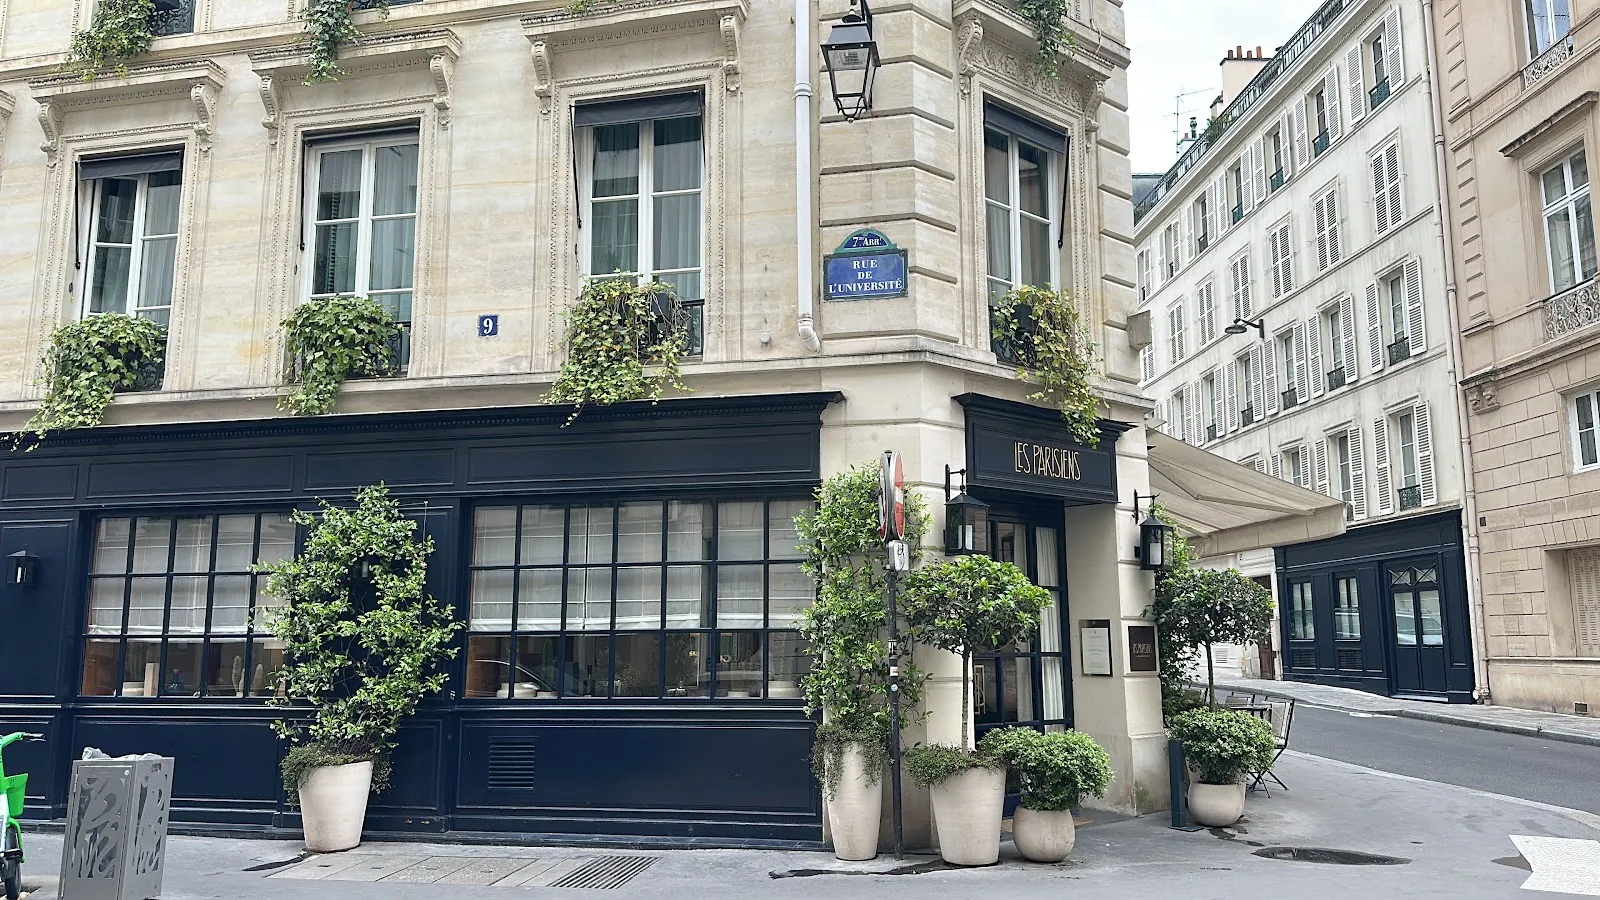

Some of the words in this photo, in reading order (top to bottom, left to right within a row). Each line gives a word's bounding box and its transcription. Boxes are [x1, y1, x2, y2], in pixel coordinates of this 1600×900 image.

[853, 259, 878, 270] RUE
[857, 271, 873, 280] DE
[829, 278, 902, 293] L'UNIVERSITÉ
[483, 318, 493, 334] 9
[1014, 441, 1031, 474] LES
[1033, 444, 1081, 480] PARISIENS
